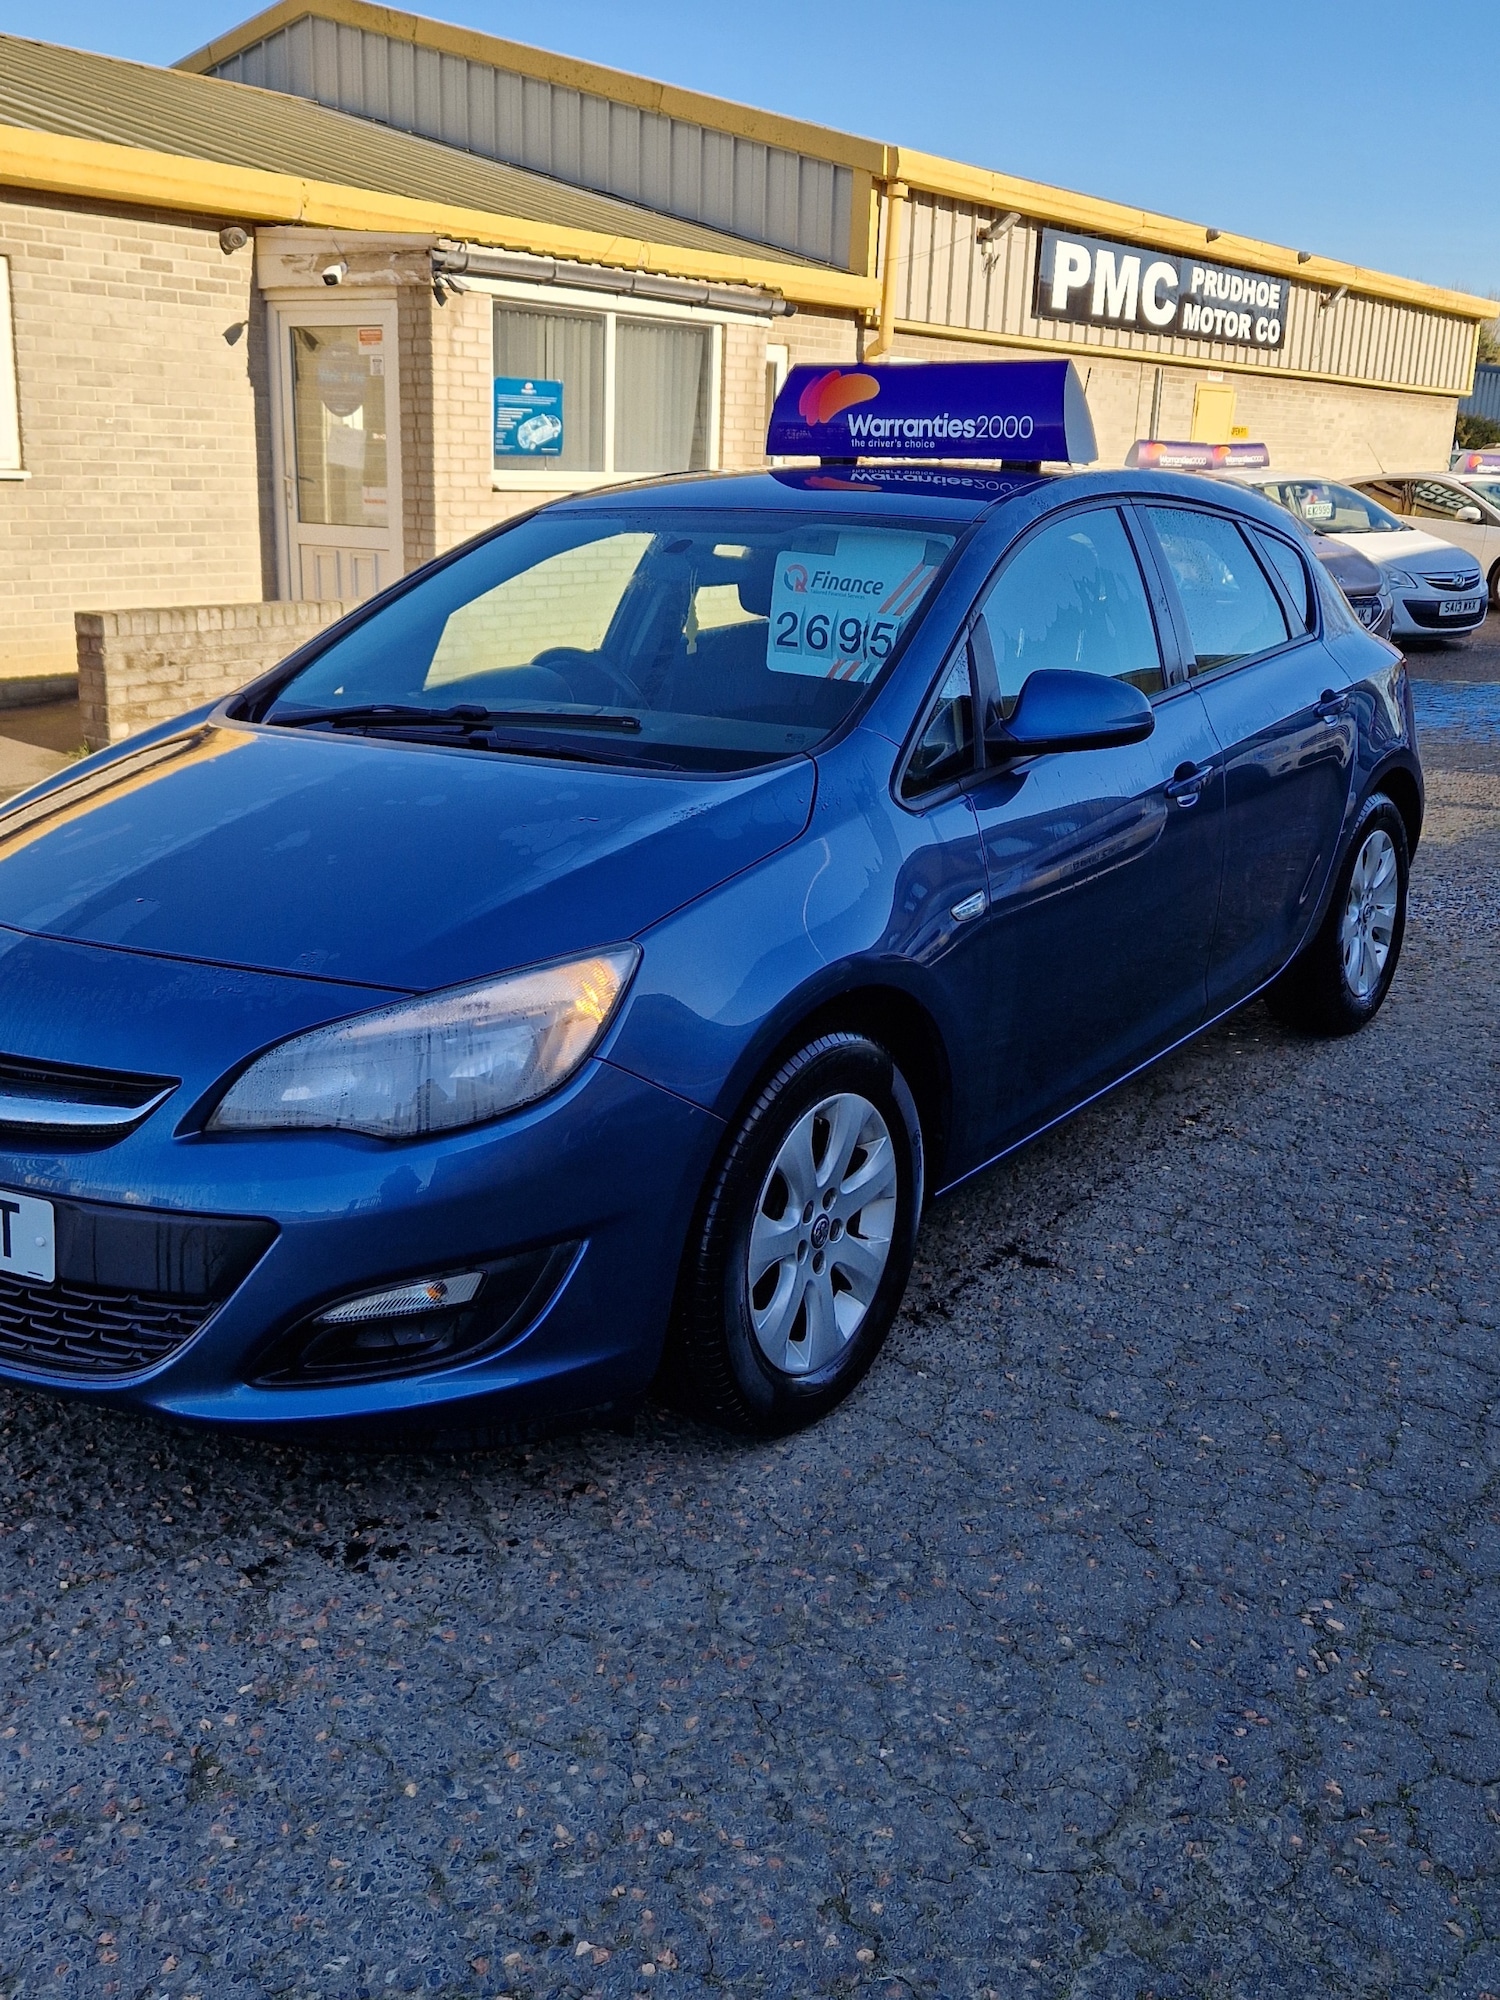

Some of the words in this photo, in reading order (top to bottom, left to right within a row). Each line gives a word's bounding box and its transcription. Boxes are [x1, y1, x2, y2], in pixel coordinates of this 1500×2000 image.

[1051, 240, 1179, 326] PMC
[1190, 266, 1281, 310] PRUDHOE
[1182, 302, 1251, 340] MOTOR
[1255, 318, 1281, 344] CO
[847, 413, 1034, 439] Warranties2000
[851, 438, 866, 448] the
[868, 439, 902, 448] driver's
[905, 439, 935, 449] choice
[810, 570, 884, 596] Finance
[776, 611, 895, 659] 2695
